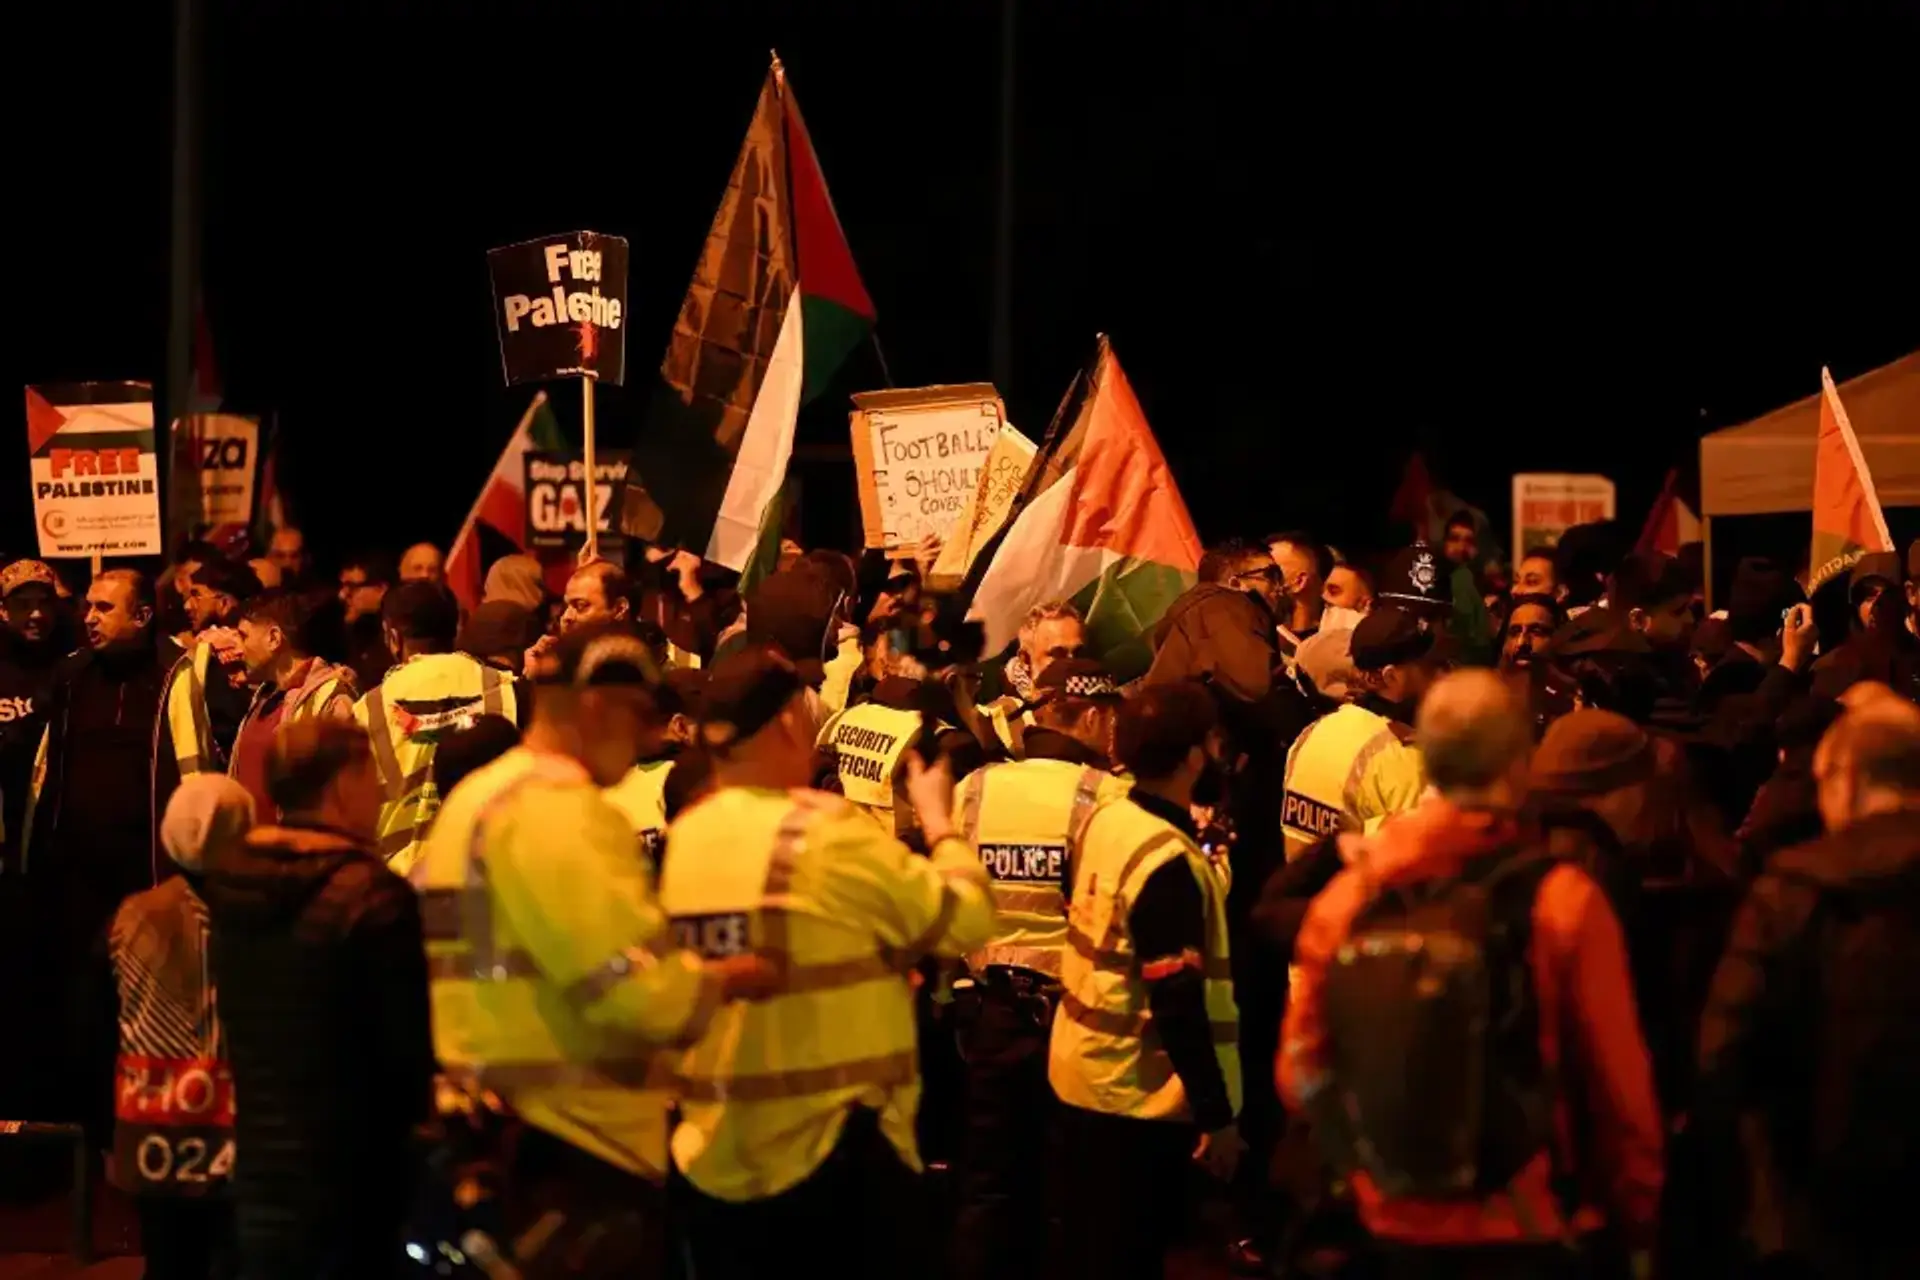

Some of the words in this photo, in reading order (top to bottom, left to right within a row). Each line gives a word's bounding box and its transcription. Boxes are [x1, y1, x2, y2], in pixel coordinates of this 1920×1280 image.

[880, 424, 989, 465] FOOTBALL
[50, 447, 140, 478] FREE
[37, 479, 154, 500] PALESTINE
[834, 724, 898, 755] SECURITY
[981, 848, 1062, 878] POLICE
